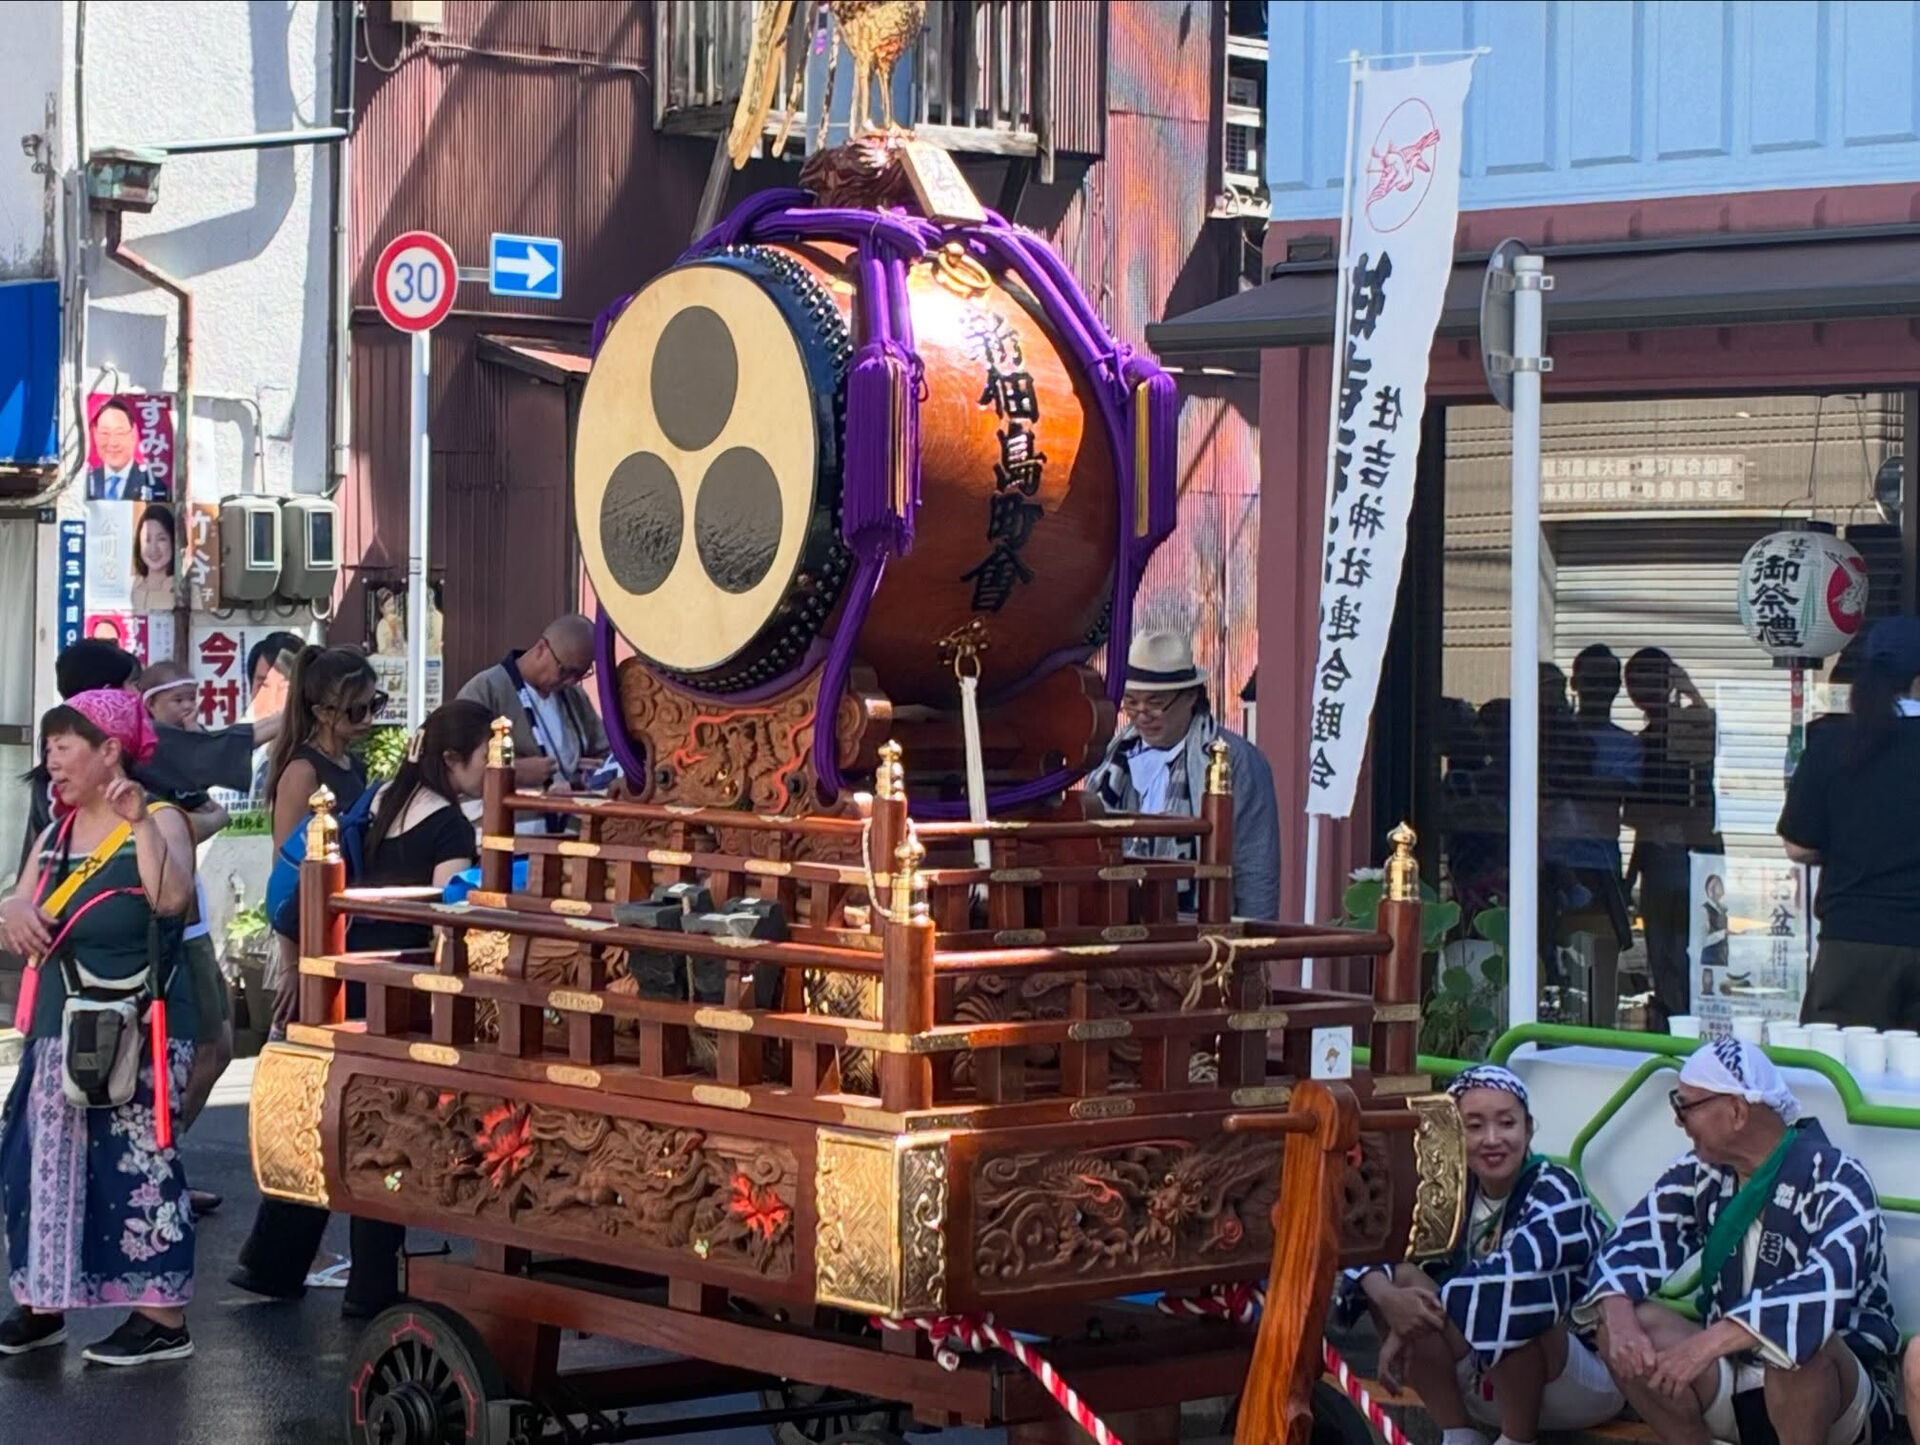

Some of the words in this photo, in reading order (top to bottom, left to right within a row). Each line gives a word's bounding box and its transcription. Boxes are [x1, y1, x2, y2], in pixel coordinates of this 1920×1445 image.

[394, 262, 438, 303] 30
[135, 398, 168, 486] すみや
[122, 616, 147, 658] すみ
[198, 631, 240, 727] 今村
